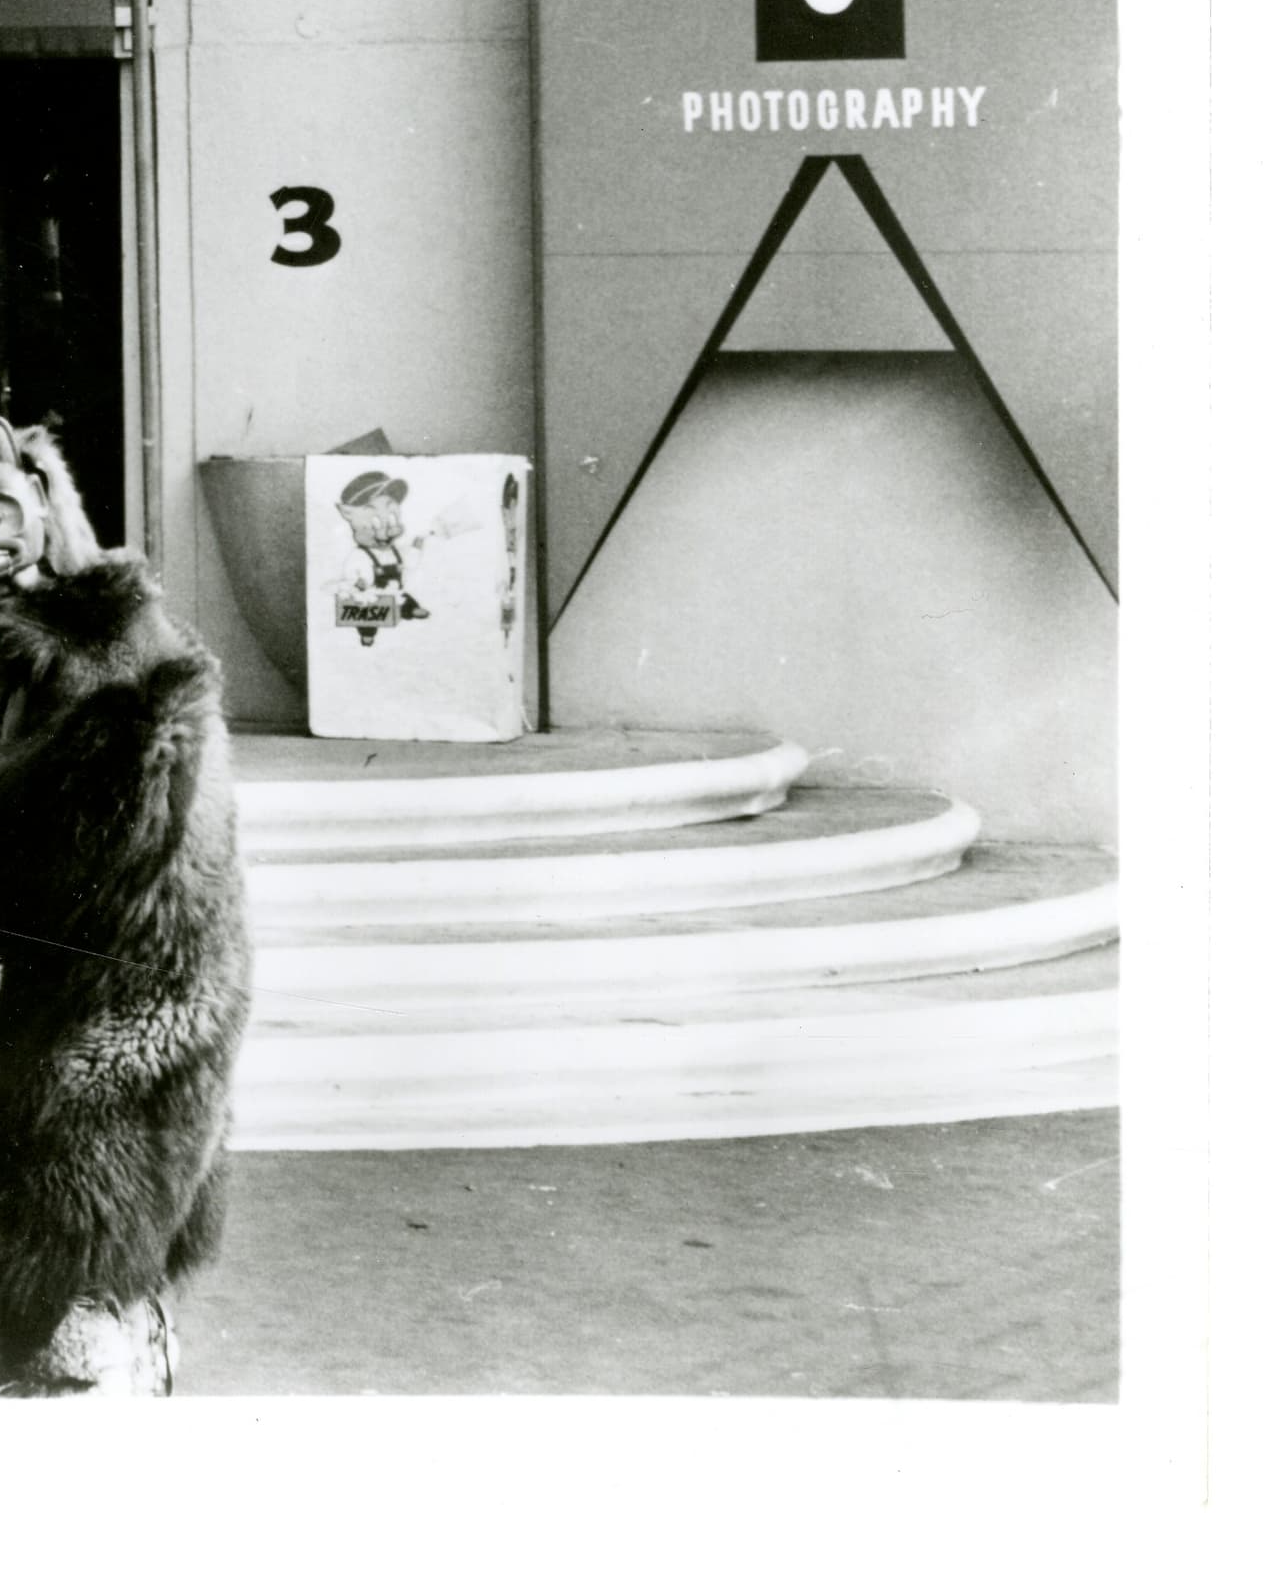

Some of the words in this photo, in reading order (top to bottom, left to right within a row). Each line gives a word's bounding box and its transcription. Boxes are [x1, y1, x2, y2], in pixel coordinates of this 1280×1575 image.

[682, 85, 987, 132] PHOTOGRAPHY
[268, 185, 342, 268] 3
[340, 604, 391, 622] TRASH
